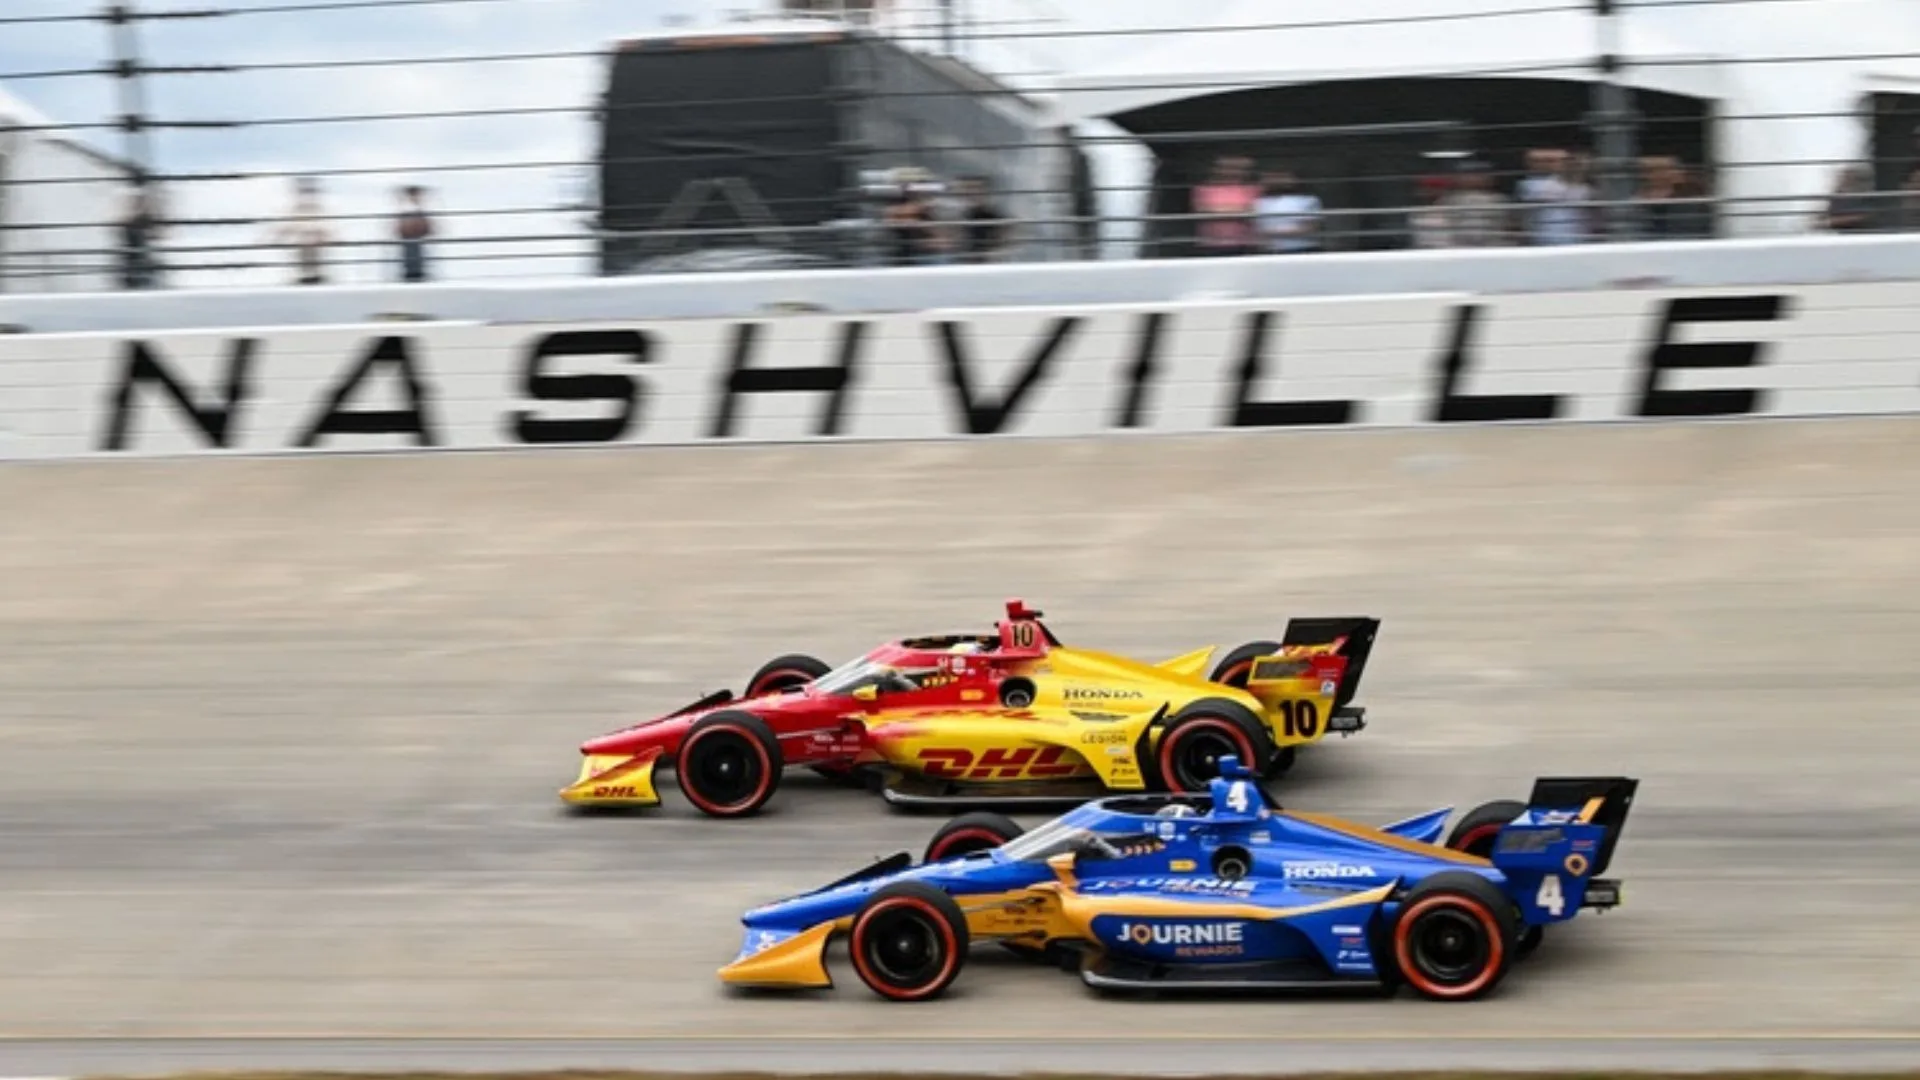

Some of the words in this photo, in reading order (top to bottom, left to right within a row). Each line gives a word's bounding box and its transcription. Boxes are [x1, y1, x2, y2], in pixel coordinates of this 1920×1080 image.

[99, 295, 1793, 450] NASHVILLE
[1011, 622, 1034, 648] 10
[1063, 688, 1143, 699] HONDA
[1280, 700, 1318, 737] 10
[918, 748, 1076, 777] DHL
[593, 786, 638, 798] DHL
[1226, 780, 1248, 813] 4
[1283, 865, 1376, 879] HONDA
[1536, 874, 1565, 916] 4
[1117, 921, 1244, 944] JOURNIE
